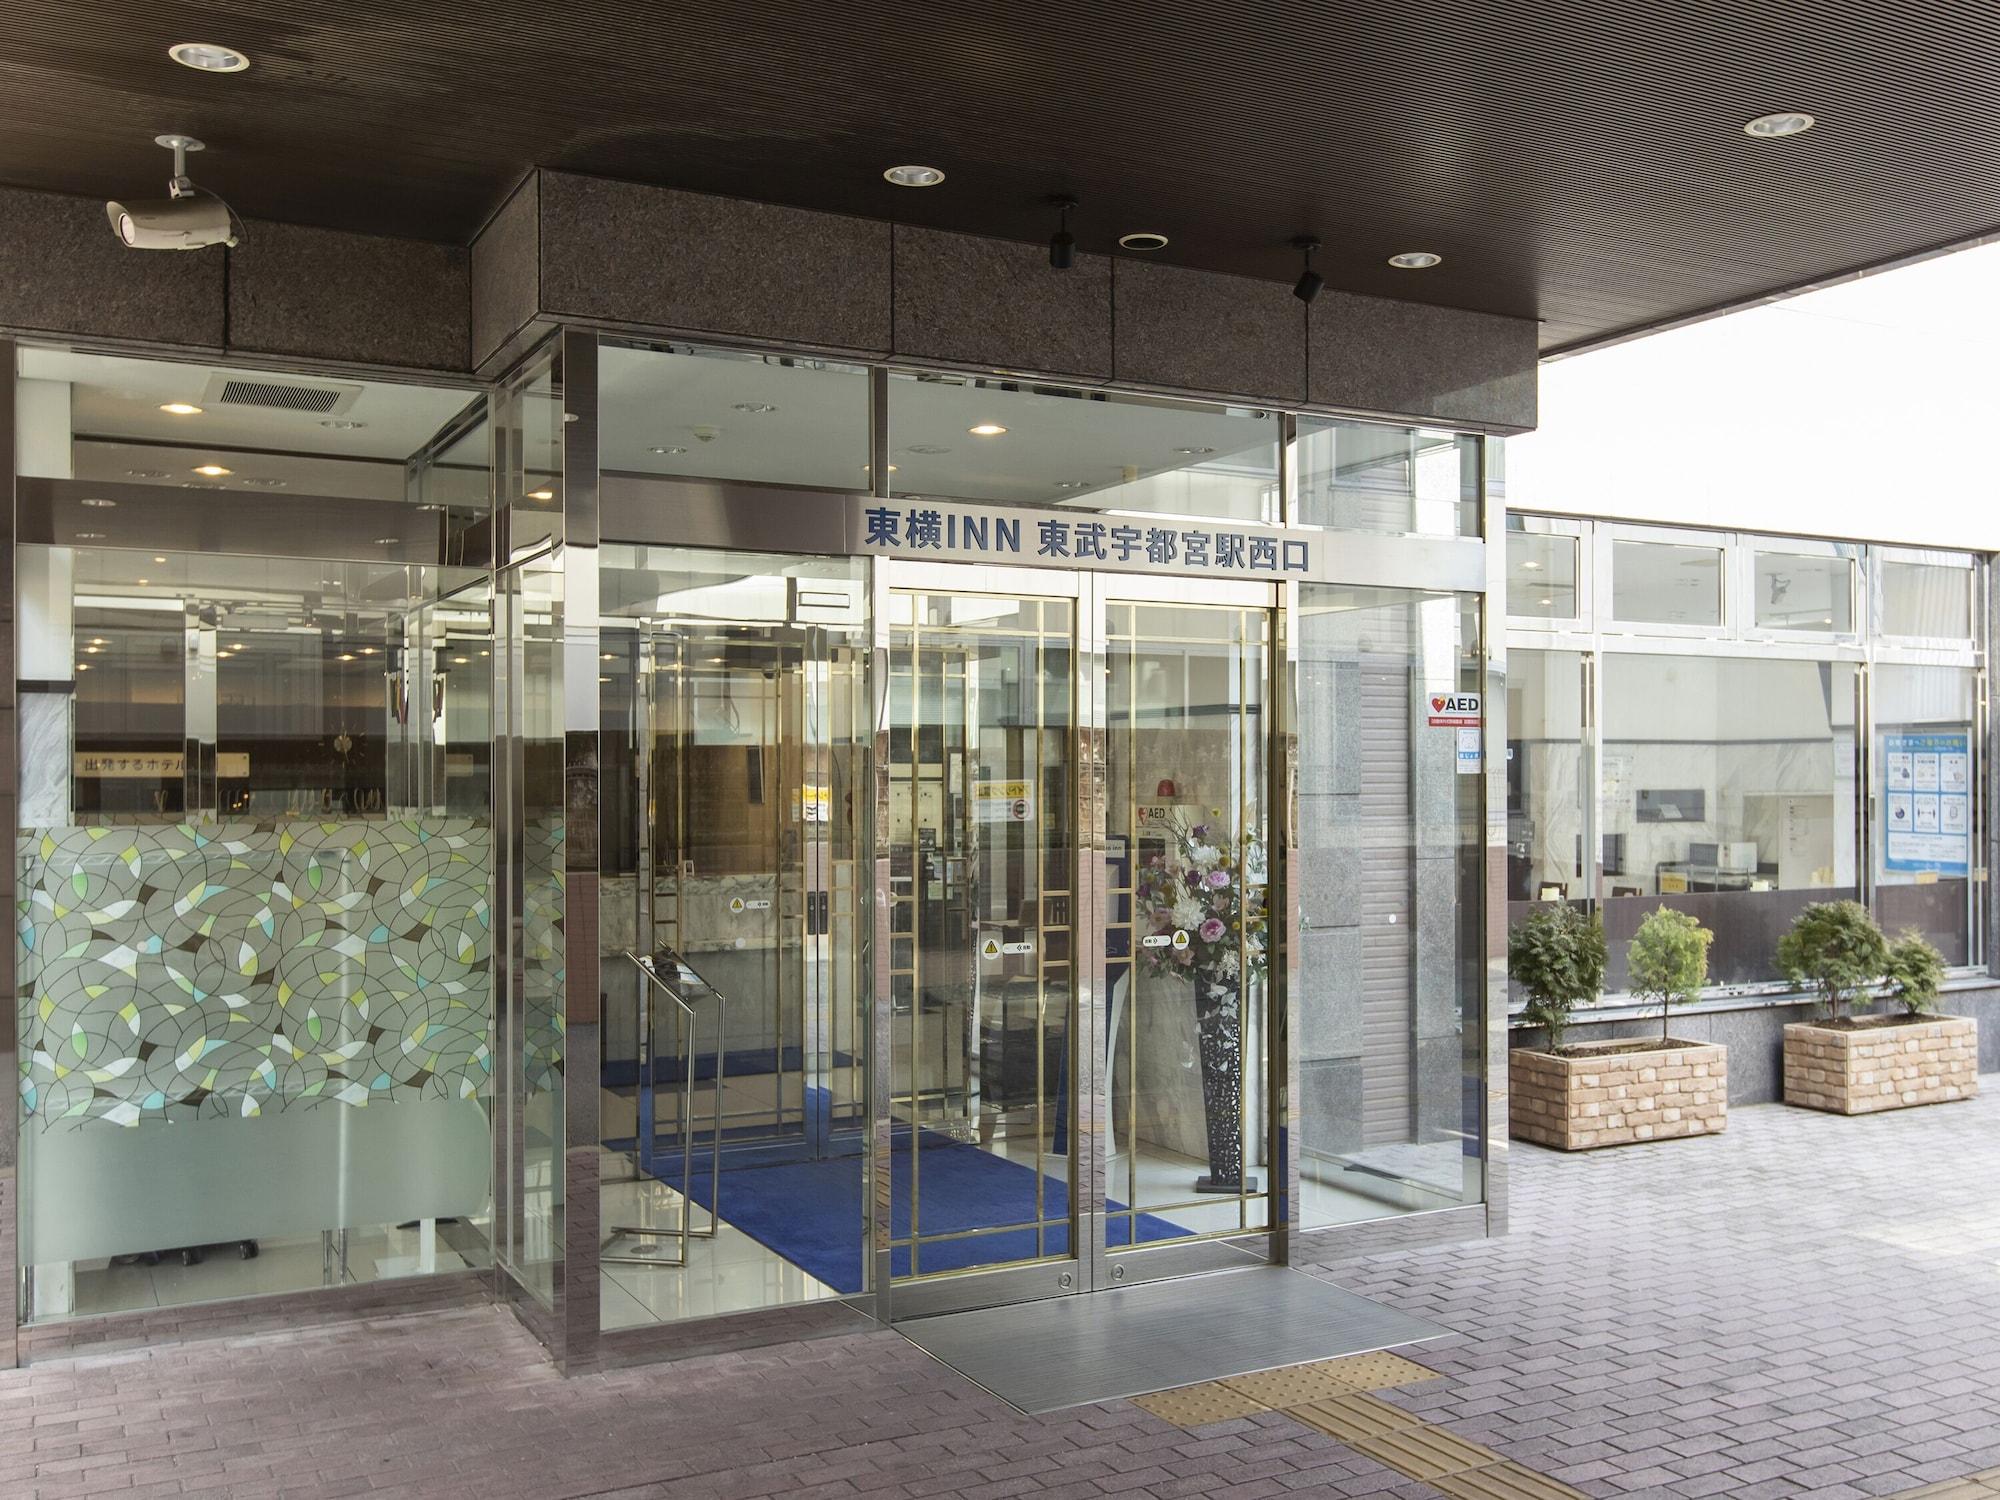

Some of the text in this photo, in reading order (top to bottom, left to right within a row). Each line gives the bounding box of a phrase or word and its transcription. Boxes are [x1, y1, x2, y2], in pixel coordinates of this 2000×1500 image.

[864, 507, 1309, 572] 東横INN 東武宇都宮駅西口
[1446, 698, 1479, 711] AED
[1149, 808, 1166, 818] AED
